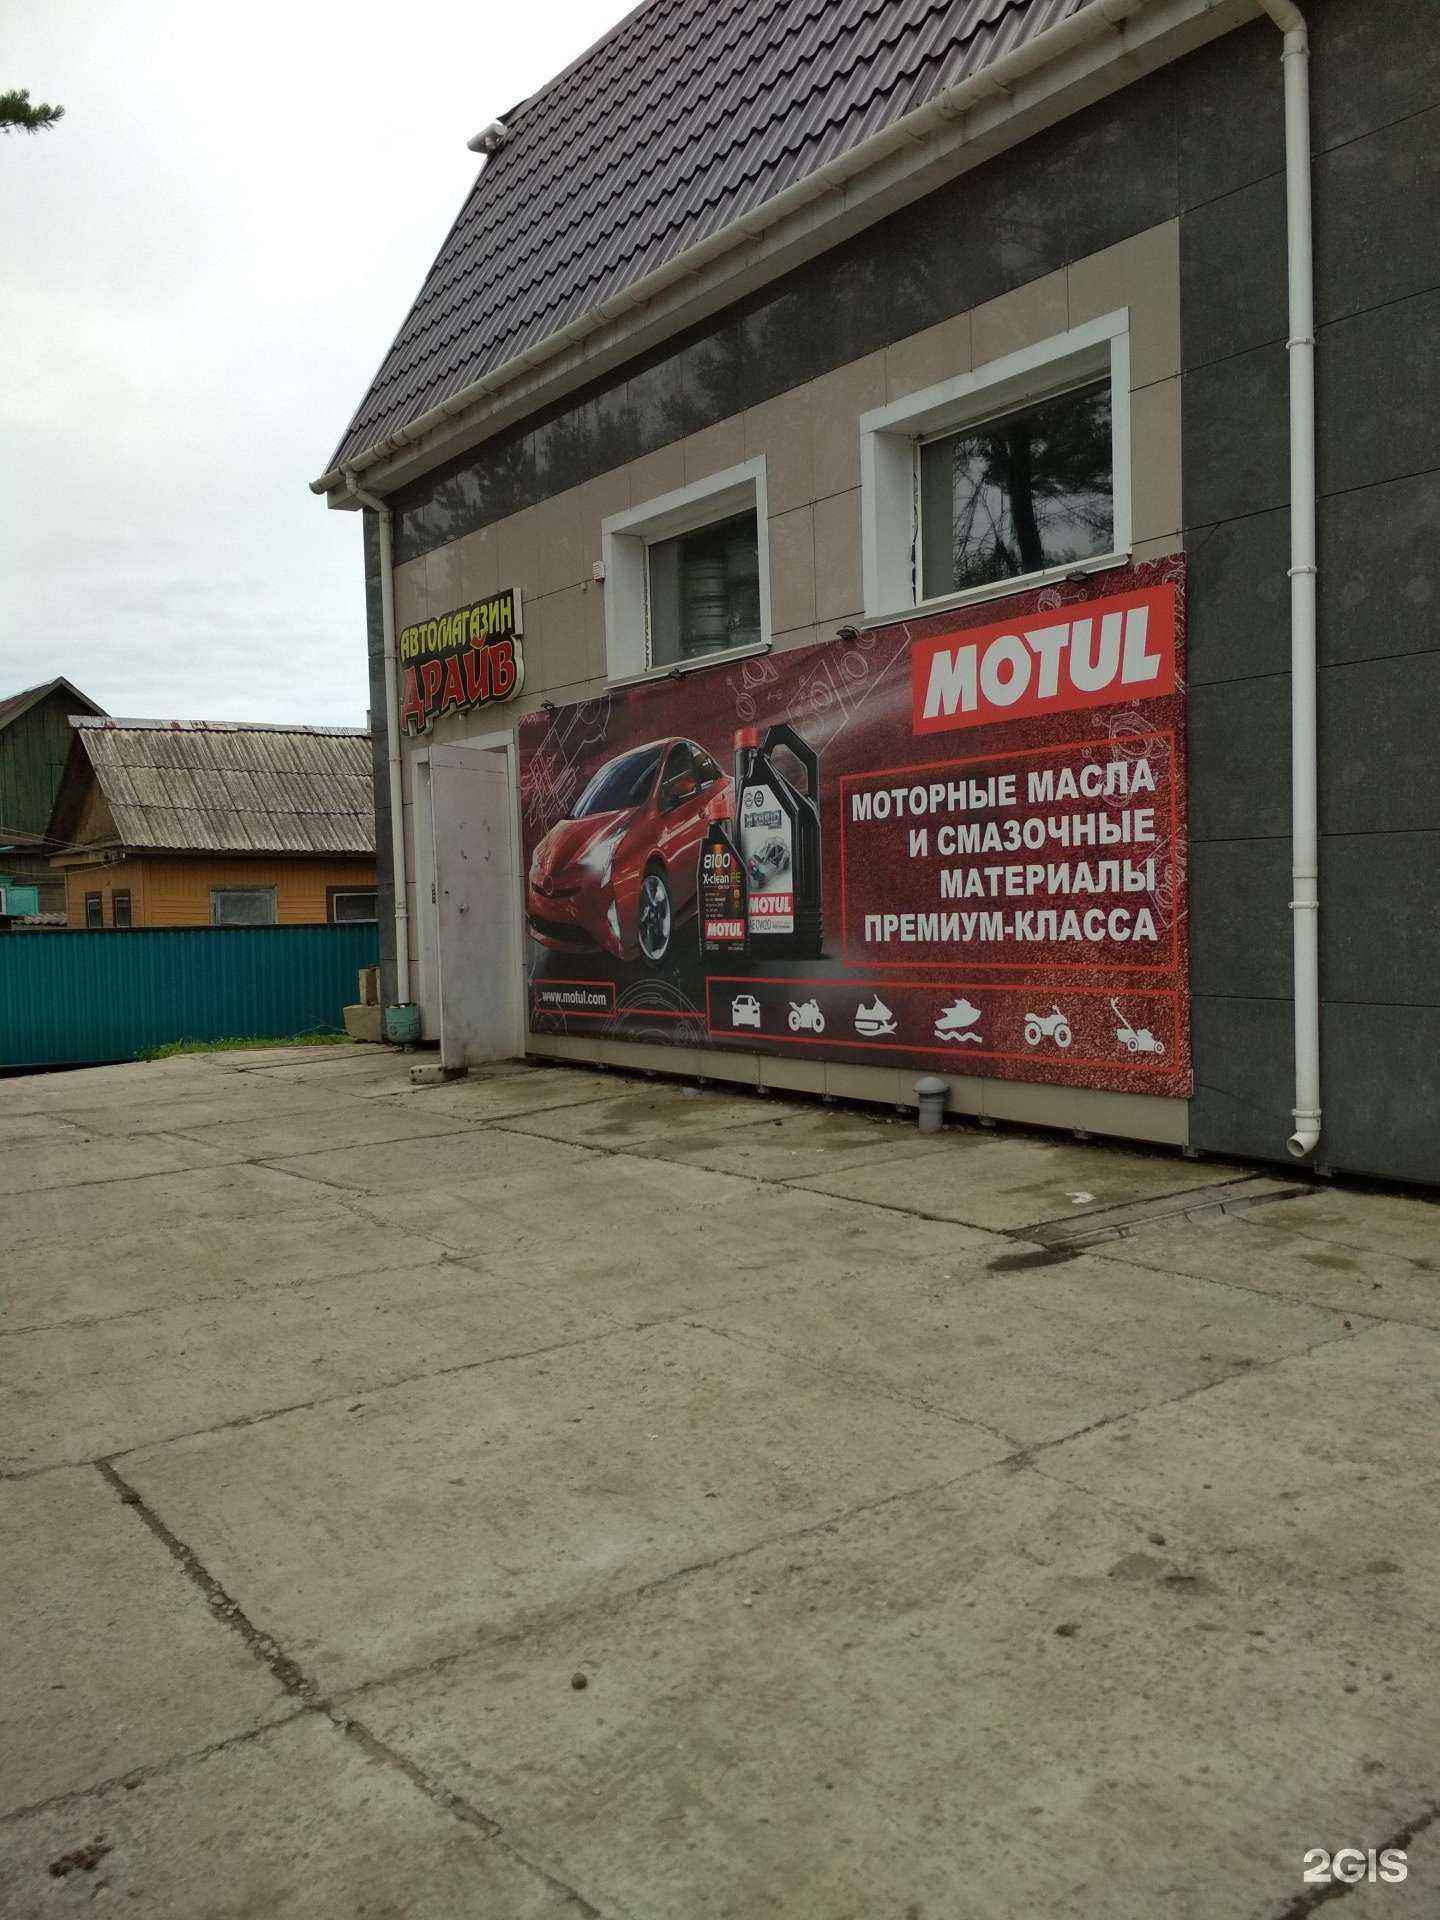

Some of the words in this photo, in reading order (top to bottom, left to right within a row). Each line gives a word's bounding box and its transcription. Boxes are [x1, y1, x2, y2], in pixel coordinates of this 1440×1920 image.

[401, 597, 512, 662] АВТОМАГАЗИН
[923, 606, 1161, 719] MOTUL
[401, 631, 515, 732] ДРАЙВ
[852, 775, 1017, 821] МОТОРНЫЕ
[1028, 758, 1156, 803] МАСЛА
[909, 829, 928, 857] И
[937, 808, 1155, 856] СМАЗОЧНЫЕ
[703, 873, 729, 884] X-clean
[704, 853, 731, 869] 8100
[940, 859, 1156, 898] МАТЕРИАЛЫ
[749, 896, 791, 913] MOTUL
[706, 923, 743, 937] MOTUL
[864, 908, 1158, 942] ПРЕМИУМ-КЛАССА
[542, 991, 607, 1006] www.motul.com
